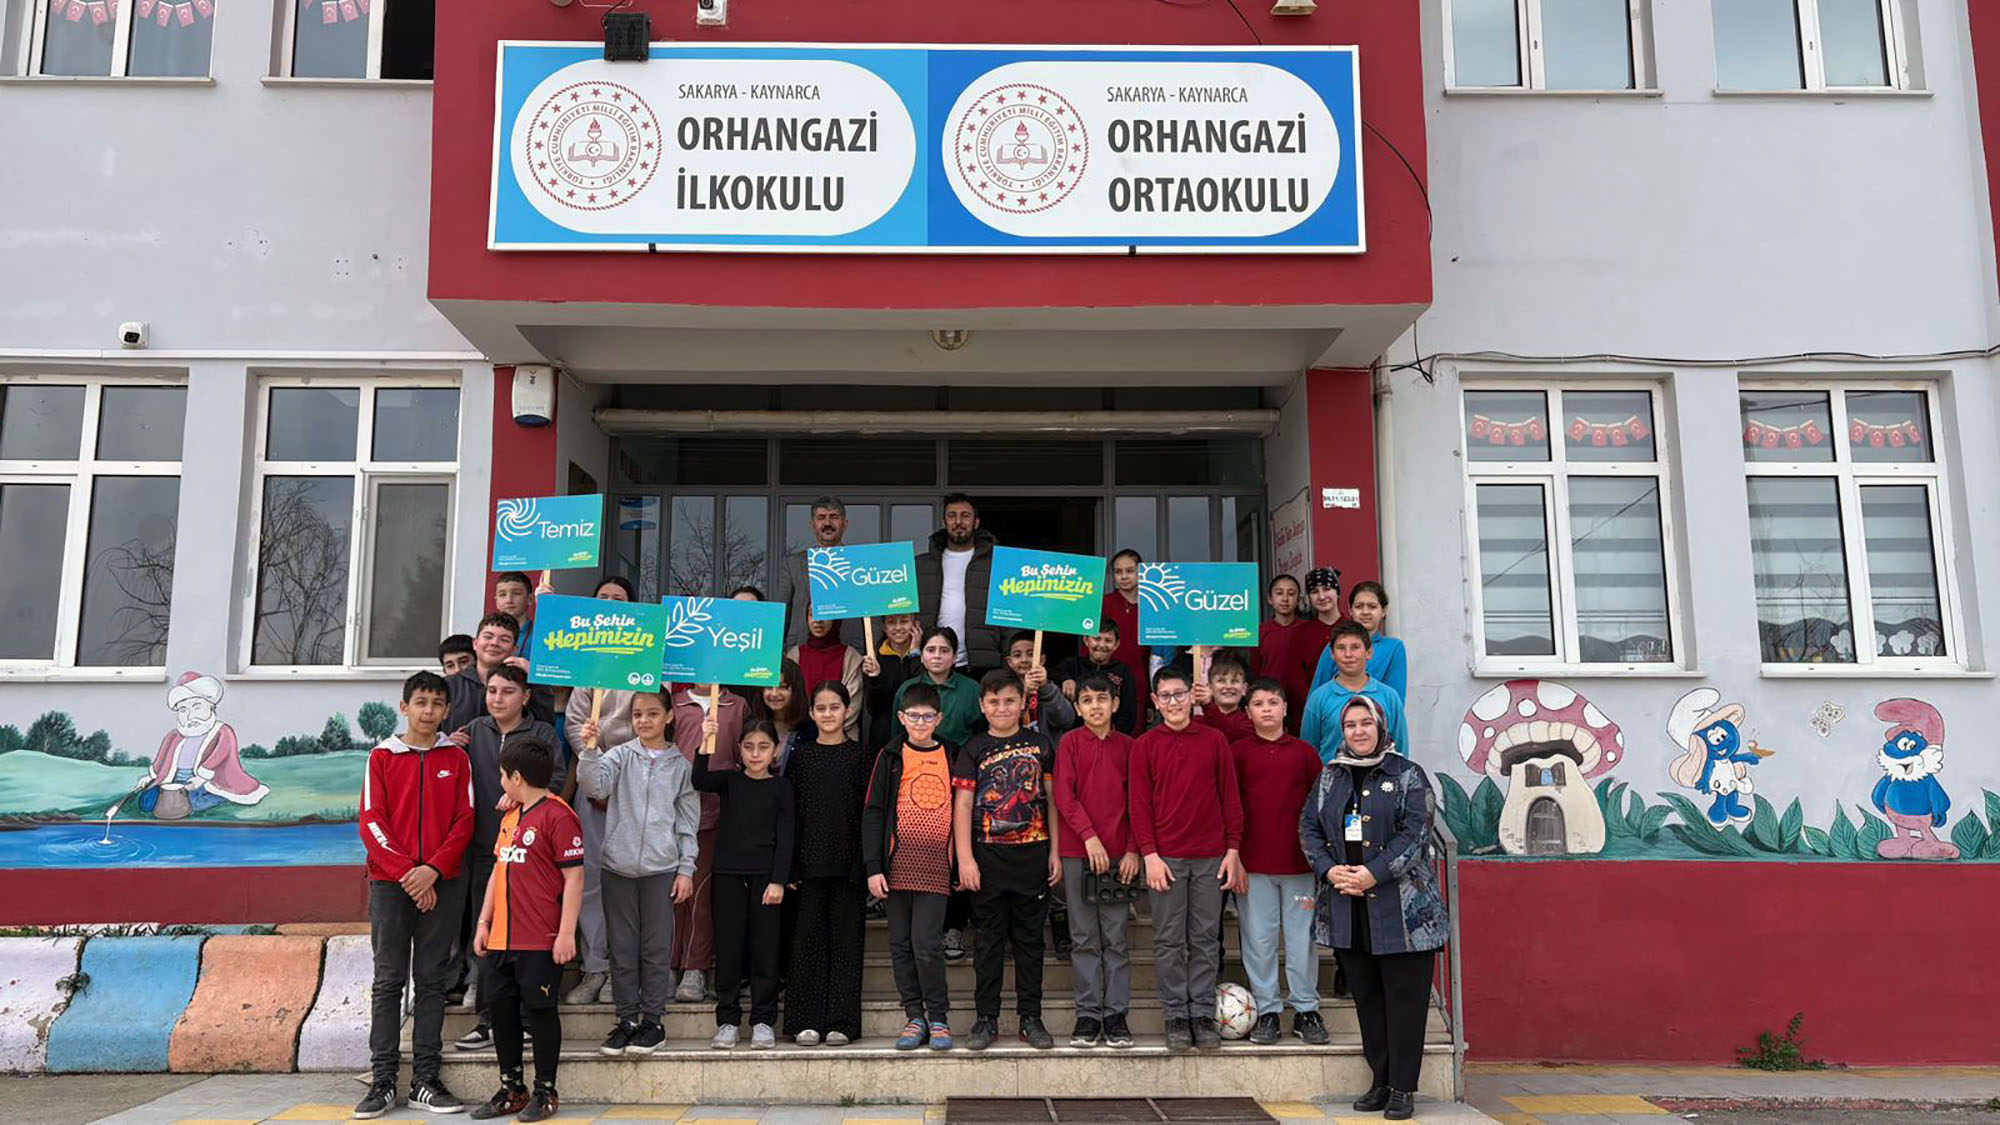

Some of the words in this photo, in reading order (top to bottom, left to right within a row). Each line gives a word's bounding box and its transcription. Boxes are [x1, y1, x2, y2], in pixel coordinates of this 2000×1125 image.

[678, 84, 739, 100] SAKARYA
[750, 84, 821, 100] KAYNARCA
[1107, 87, 1167, 103] SAKARYA
[1179, 87, 1248, 103] KAYNARCA
[677, 111, 878, 153] ORHANGAZİ
[1107, 113, 1307, 154] ORHANGAZİ
[677, 167, 845, 211] İLKOKULU
[1108, 177, 1309, 213] ORTAOKULU
[537, 519, 594, 540] Temiz
[851, 564, 908, 586] Güzel
[1020, 564, 1039, 577] Bu
[1039, 563, 1077, 579] Şehir
[999, 574, 1094, 596] Hepimizin
[1184, 589, 1249, 611] Güzel
[569, 614, 591, 629] Bu
[593, 613, 636, 630] Şehir
[543, 627, 655, 651] Hepimizin
[707, 625, 763, 652] Yeşil
